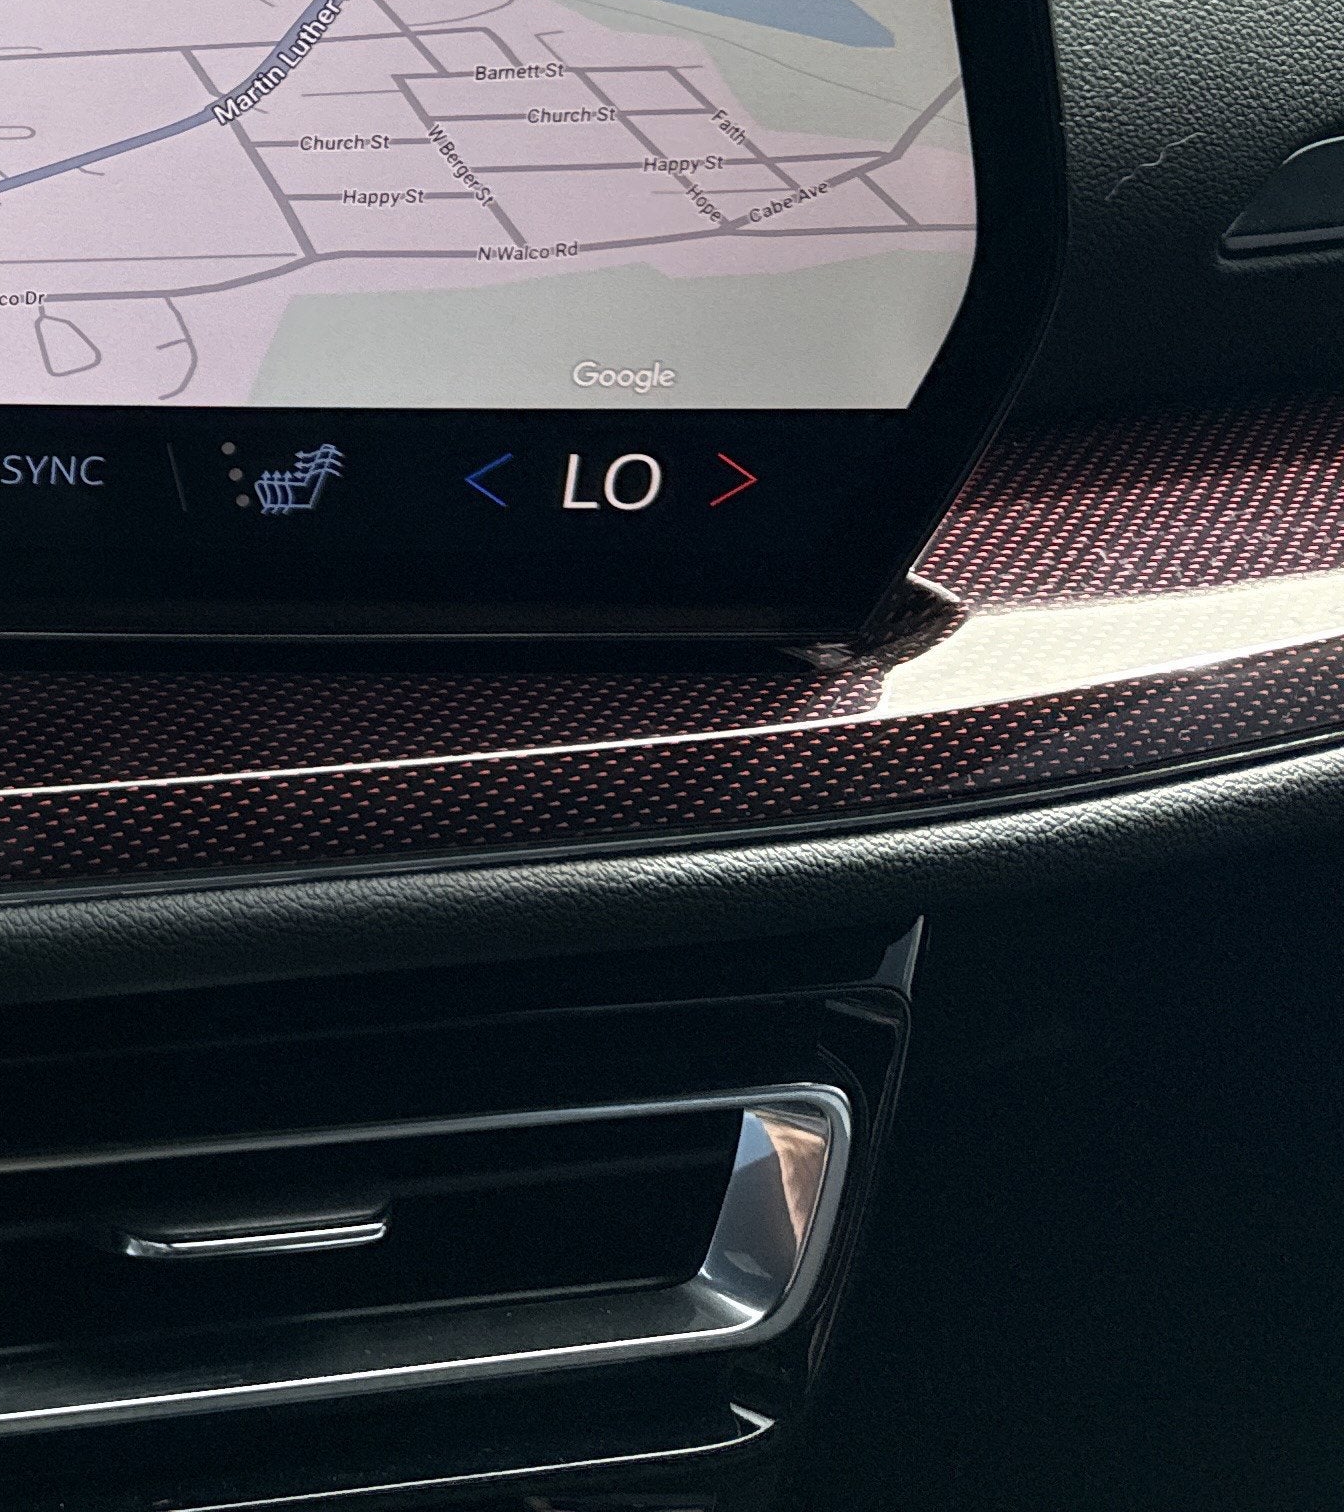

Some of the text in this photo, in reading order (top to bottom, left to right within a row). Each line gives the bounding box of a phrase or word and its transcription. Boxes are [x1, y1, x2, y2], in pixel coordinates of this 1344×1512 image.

[475, 64, 564, 81] Barnett St
[212, 65, 286, 126] Martin
[527, 107, 616, 124] Church St
[300, 135, 390, 151] Church St
[428, 124, 494, 207] W Berger St
[643, 155, 724, 175] Happy St
[343, 189, 424, 207] Happy St
[685, 183, 721, 223] Hope
[749, 181, 829, 223] Cabe Ave
[477, 242, 578, 261] N Walco Rd
[25, 291, 46, 306] Dr
[572, 361, 676, 393] Google
[0, 454, 106, 487] SYNC
[563, 453, 662, 511] LO
